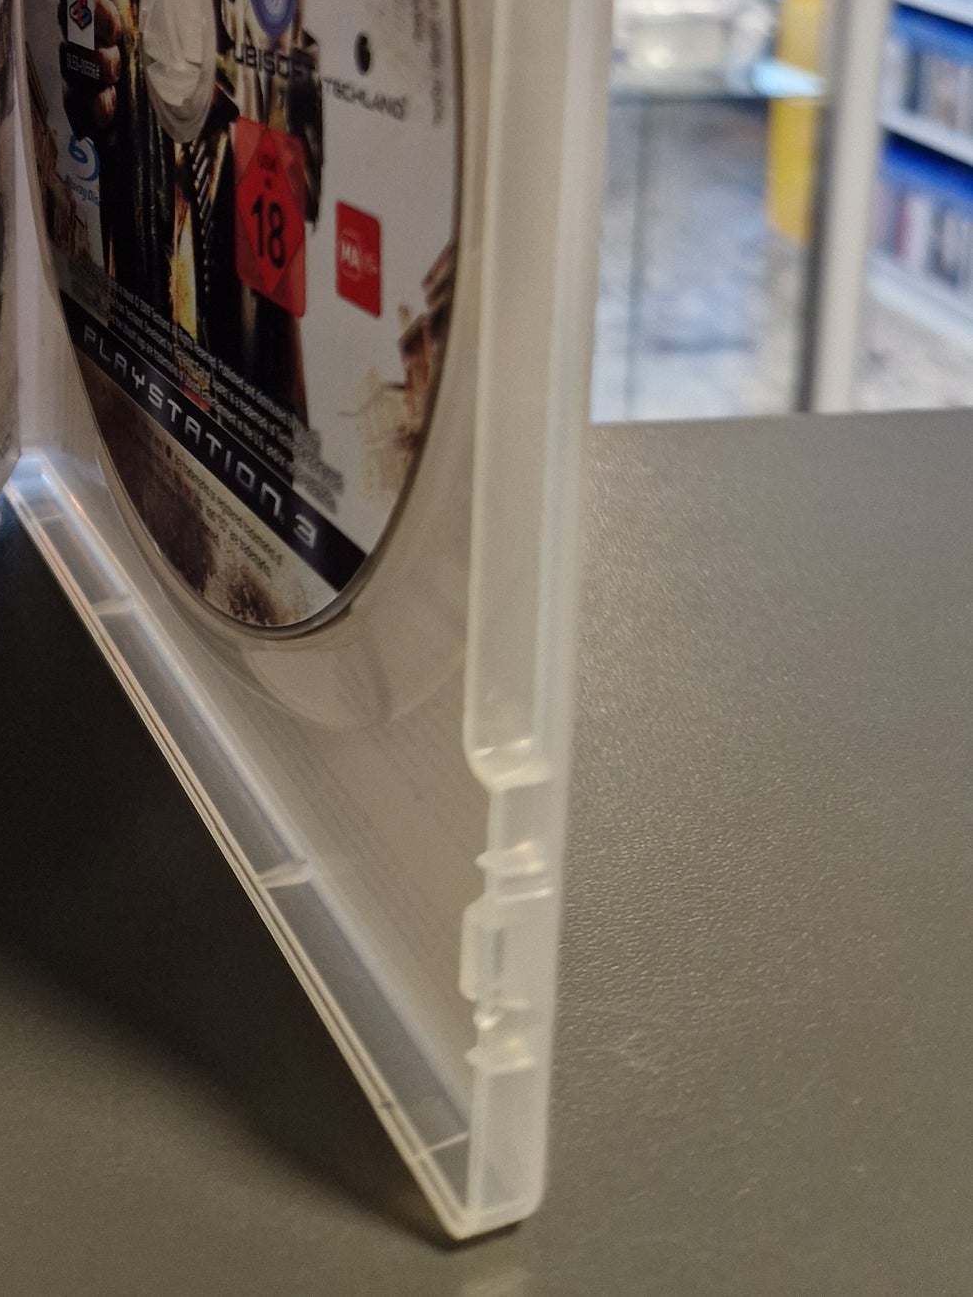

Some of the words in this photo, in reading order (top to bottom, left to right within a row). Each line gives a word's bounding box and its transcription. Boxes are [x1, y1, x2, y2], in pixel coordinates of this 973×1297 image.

[251, 195, 285, 270] 18
[83, 324, 284, 516] PLAYSTATION
[294, 513, 318, 550] 3
